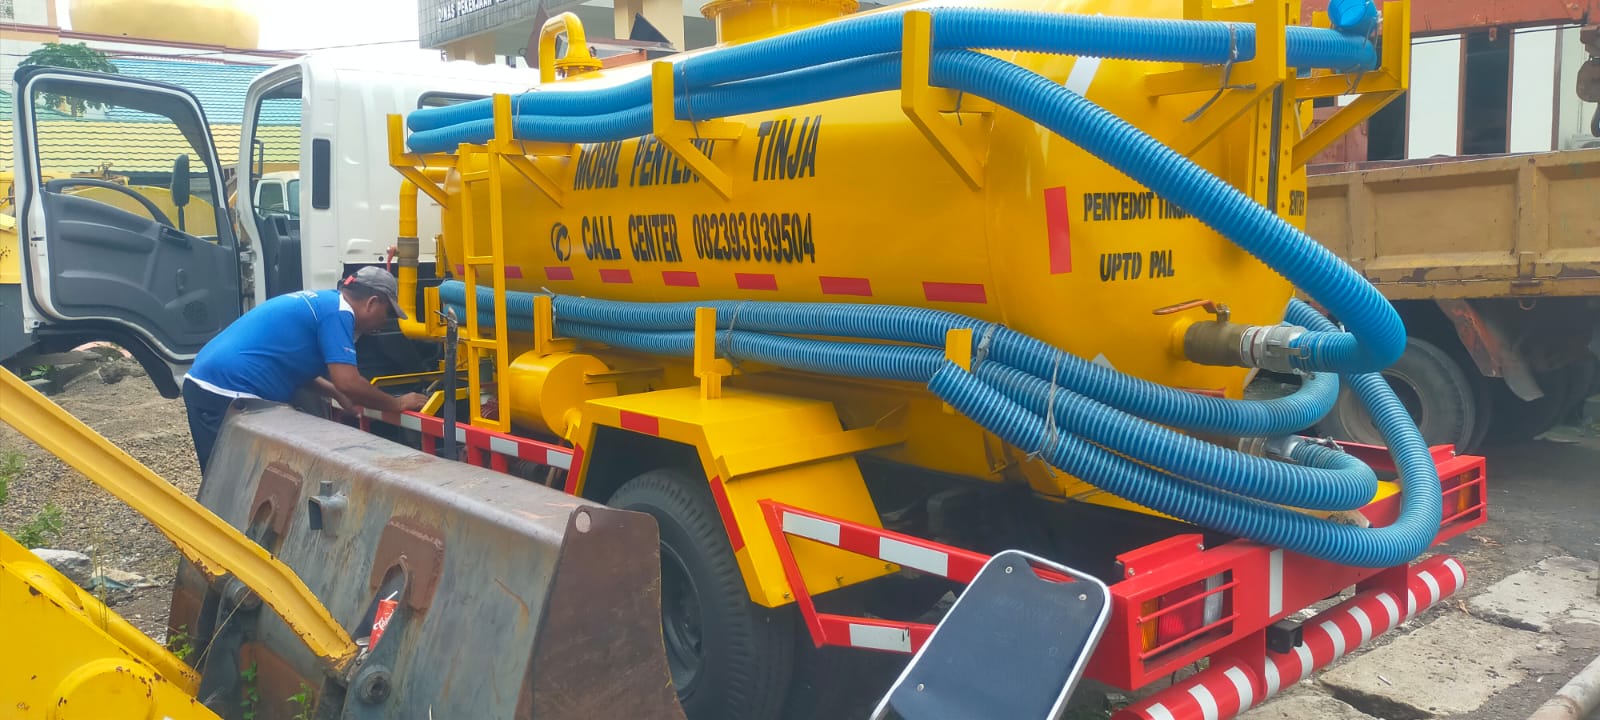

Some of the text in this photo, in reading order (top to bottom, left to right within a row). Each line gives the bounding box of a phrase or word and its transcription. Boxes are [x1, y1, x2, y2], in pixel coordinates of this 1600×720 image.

[573, 140, 624, 191] MOBIL
[753, 115, 822, 182] TINJA
[1083, 191, 1154, 222] PENYEDOT
[581, 215, 622, 262] CALL
[628, 214, 683, 263] CENTER
[1100, 249, 1176, 282] UPTD PAL
